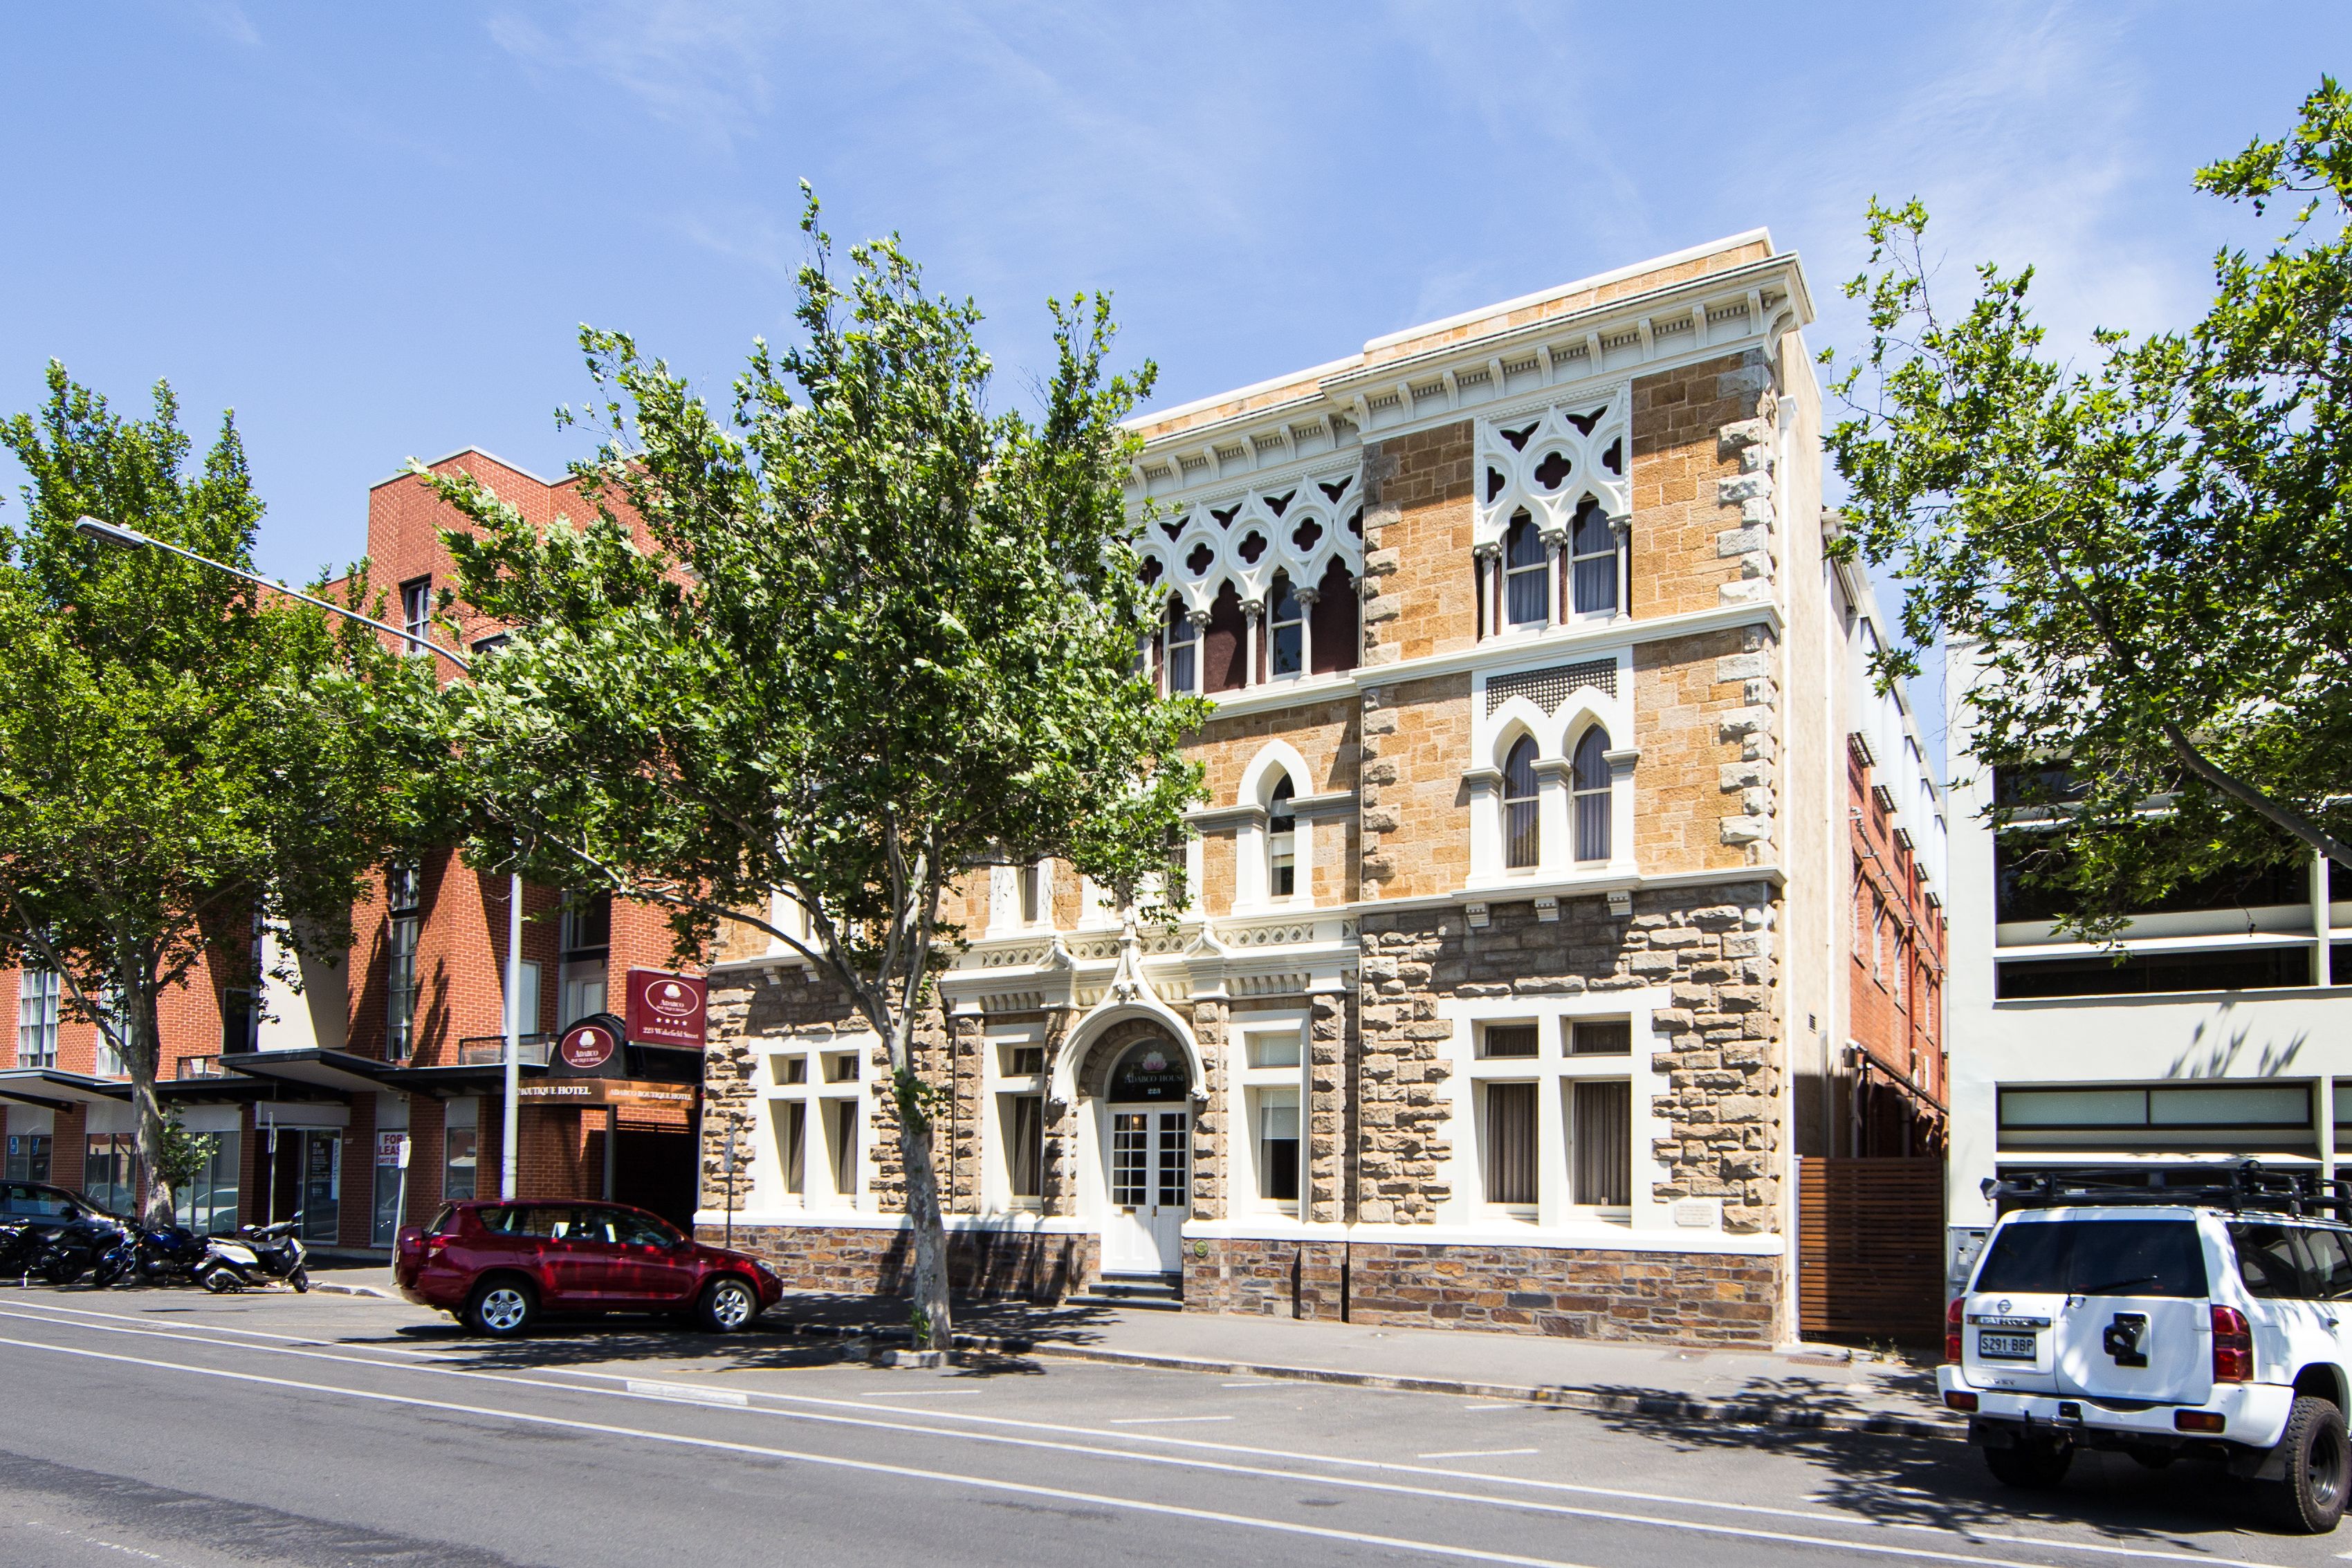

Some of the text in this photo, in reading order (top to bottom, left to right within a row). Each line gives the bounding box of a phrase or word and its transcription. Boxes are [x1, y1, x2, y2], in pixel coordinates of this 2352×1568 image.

[654, 1027, 683, 1037] Wakefield
[683, 1031, 699, 1040] Street
[1124, 1072, 1157, 1084] ADABCO
[558, 1086, 591, 1096] HOTEL
[609, 1089, 693, 1101] ADABCO BOUTIQUE HOTEL
[384, 1134, 403, 1145] FOR
